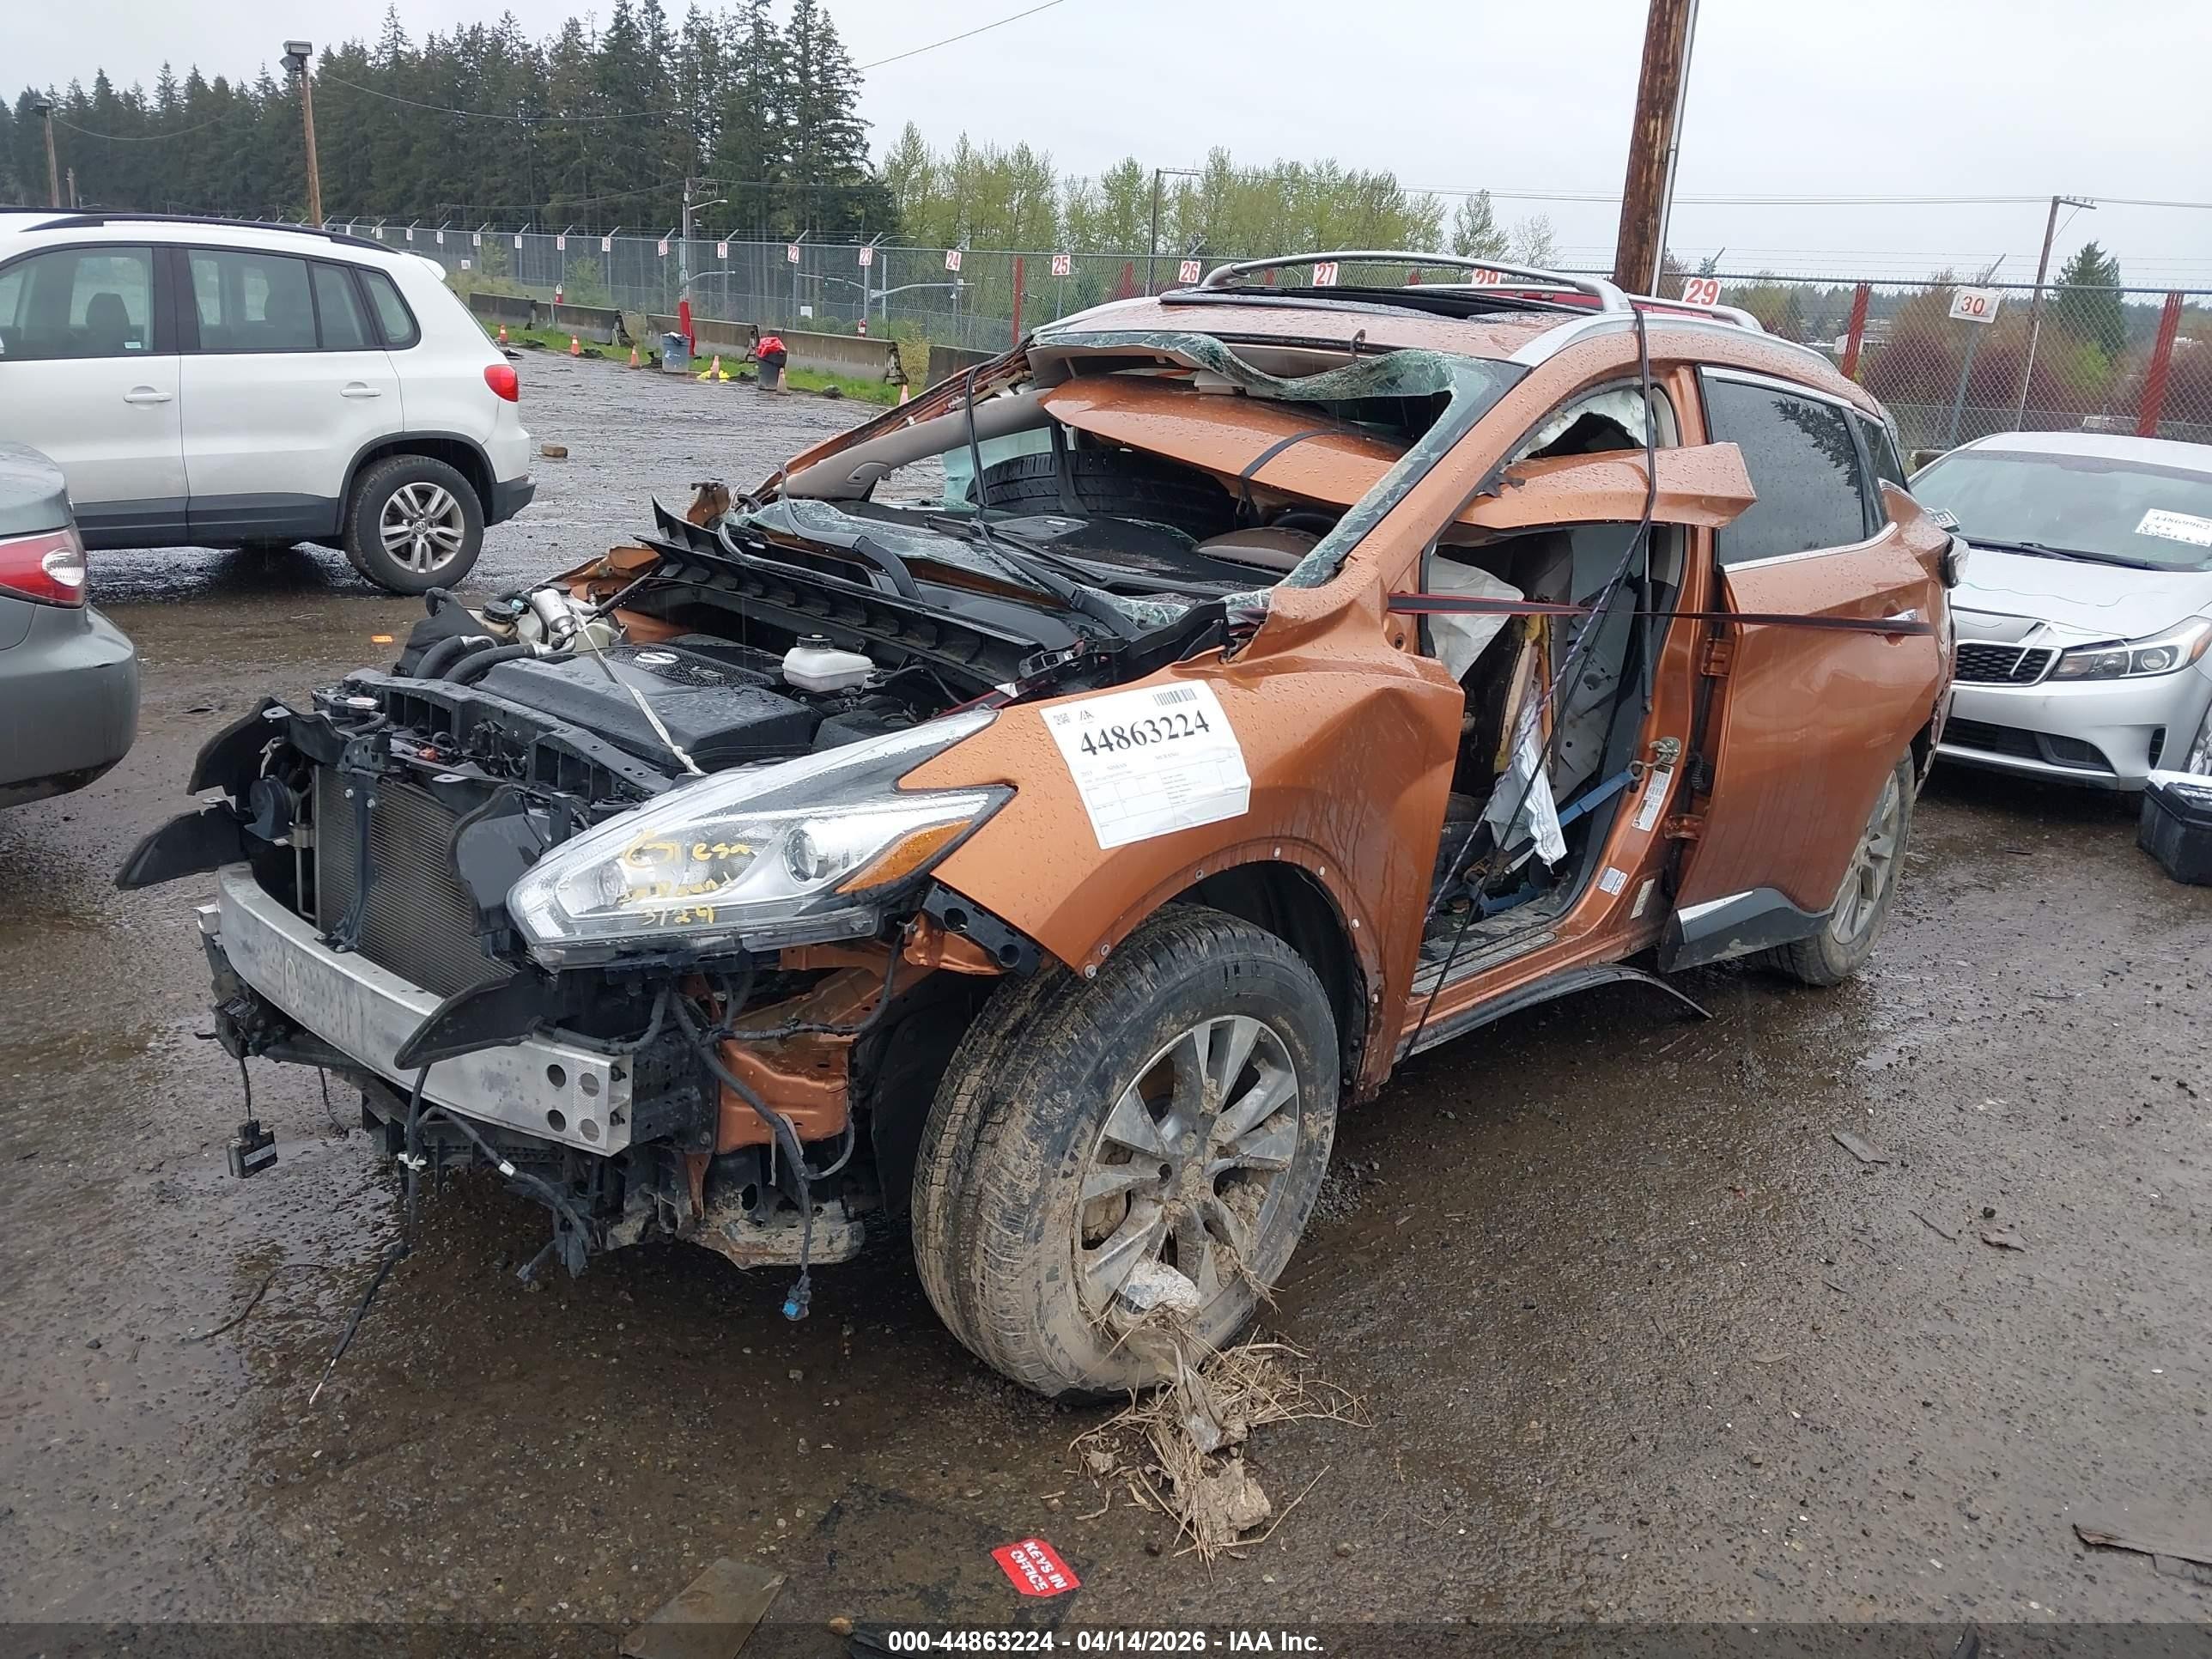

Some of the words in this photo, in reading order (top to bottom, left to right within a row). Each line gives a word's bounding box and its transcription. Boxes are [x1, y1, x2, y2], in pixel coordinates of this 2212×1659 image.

[604, 238, 610, 250] 19
[659, 240, 667, 255] 20
[719, 243, 726, 258] 21
[789, 246, 798, 262] 22
[860, 249, 872, 264] 23
[947, 252, 959, 270] 24
[1054, 257, 1069, 274] 25
[1181, 263, 1198, 282] 26
[1316, 264, 1335, 285] 27
[1686, 279, 1718, 305] 29
[1961, 295, 1985, 314] 30
[1080, 709, 1210, 756] 44863224
[1010, 1550, 1049, 1593] OFFICE
[1023, 1541, 1054, 1574] KEYS
[1048, 1573, 1068, 1589] IN
